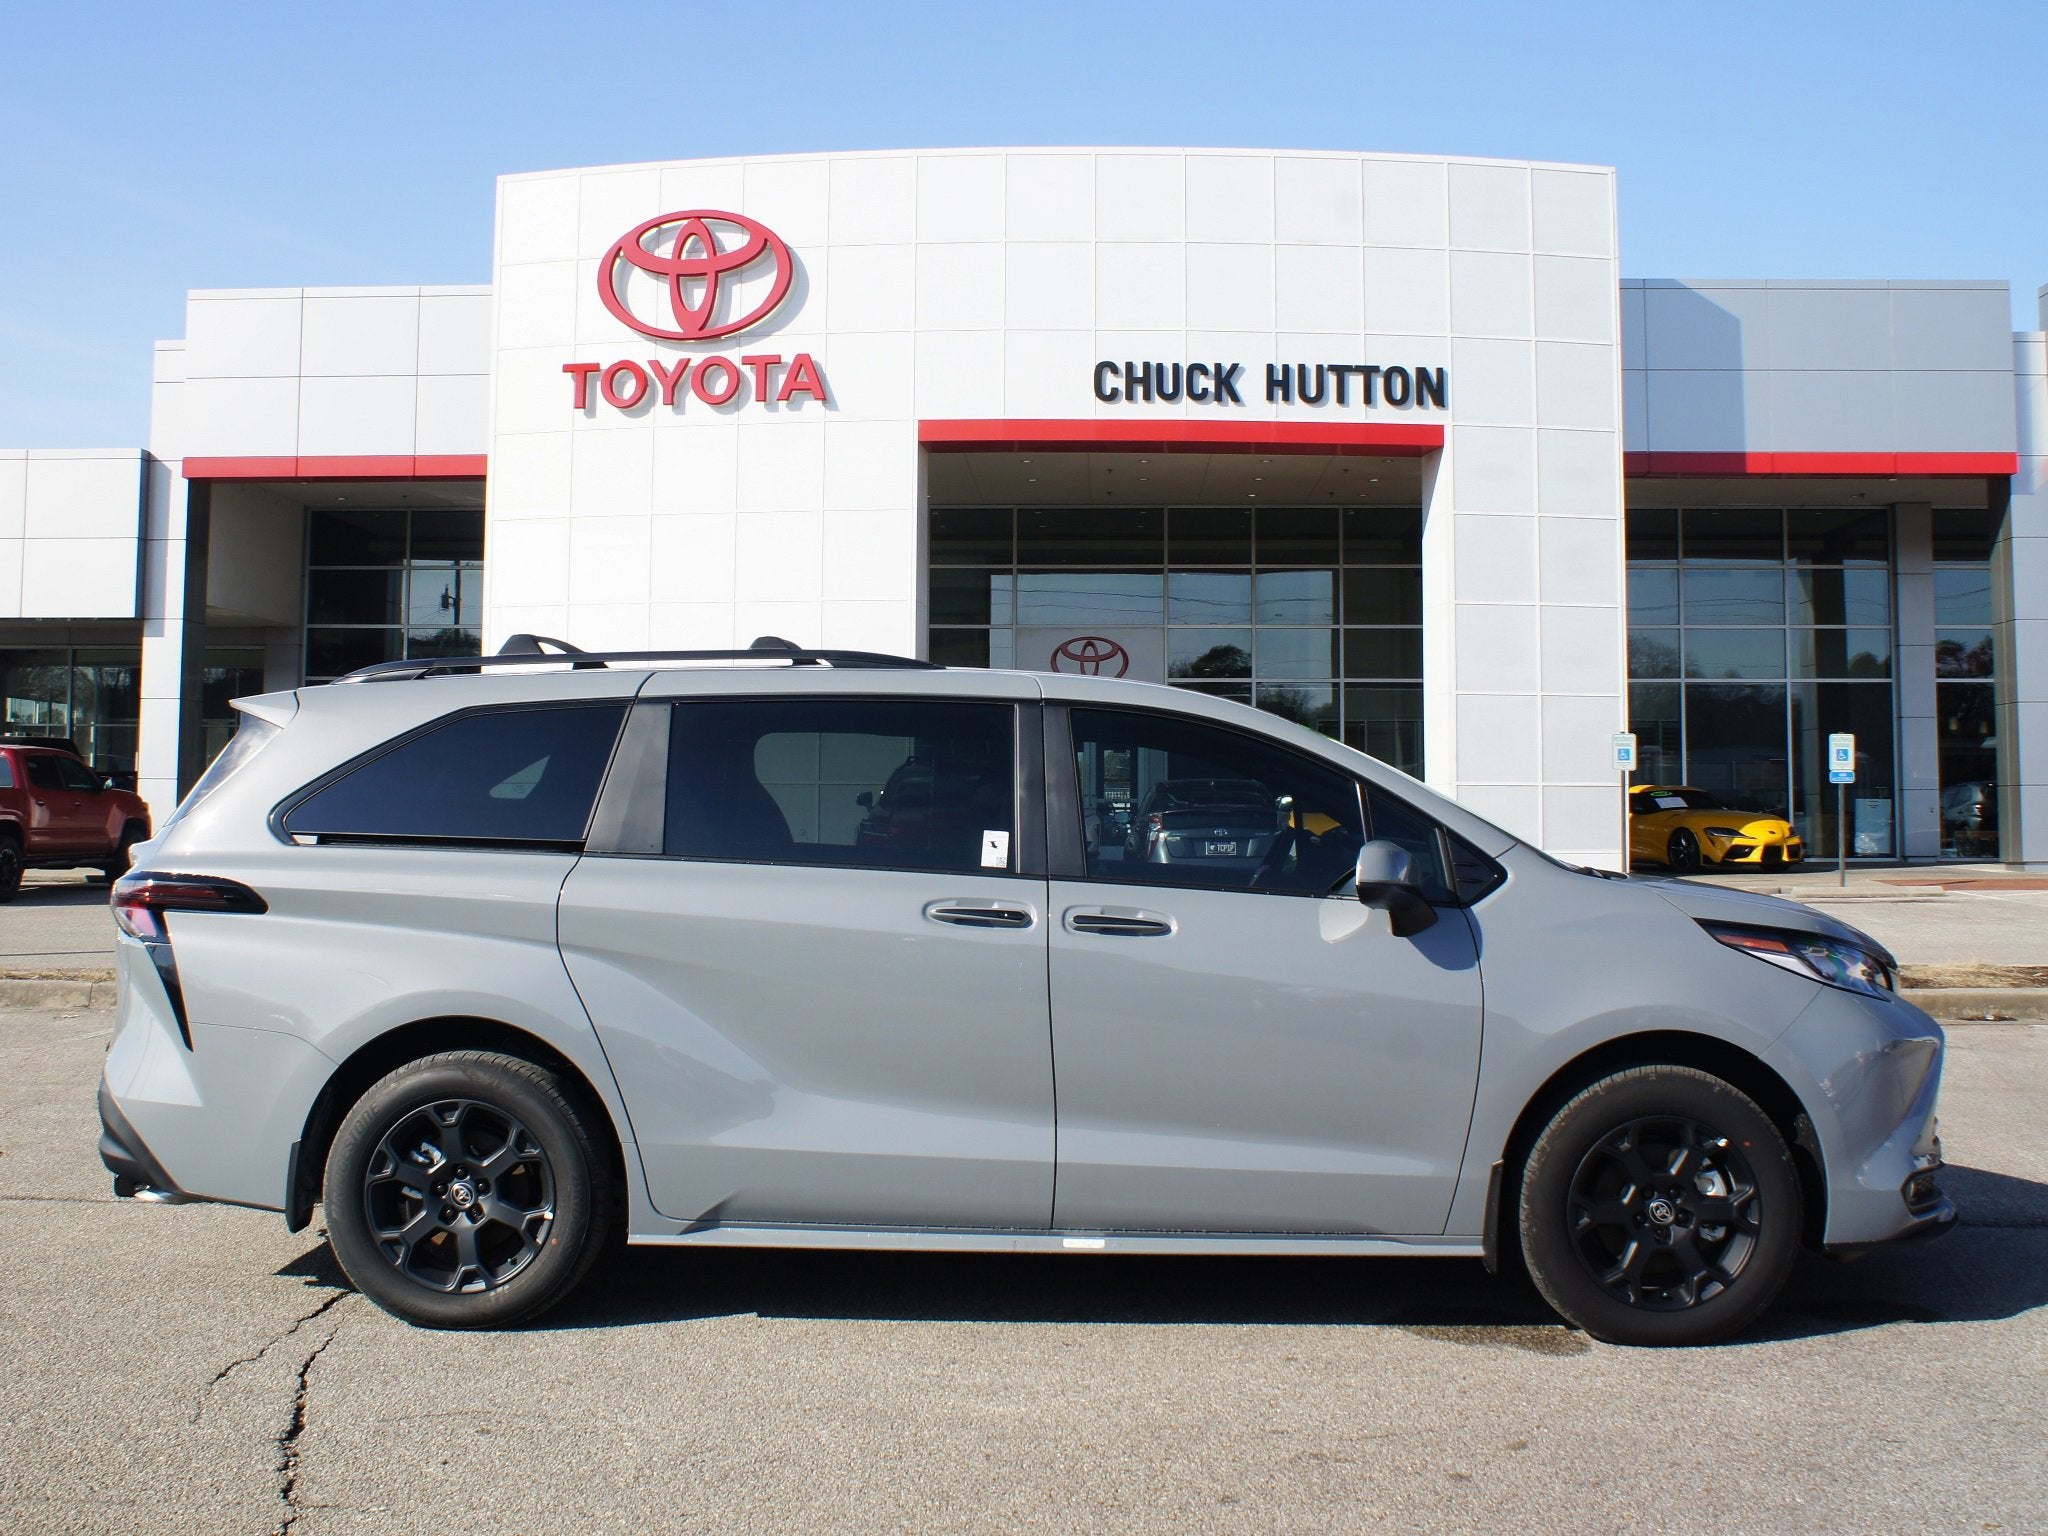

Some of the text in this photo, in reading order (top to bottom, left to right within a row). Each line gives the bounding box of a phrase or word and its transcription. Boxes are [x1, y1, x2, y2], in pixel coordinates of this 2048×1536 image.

[562, 353, 827, 409] TOYOTA
[1094, 360, 1446, 408] CHUCK HUTTON
